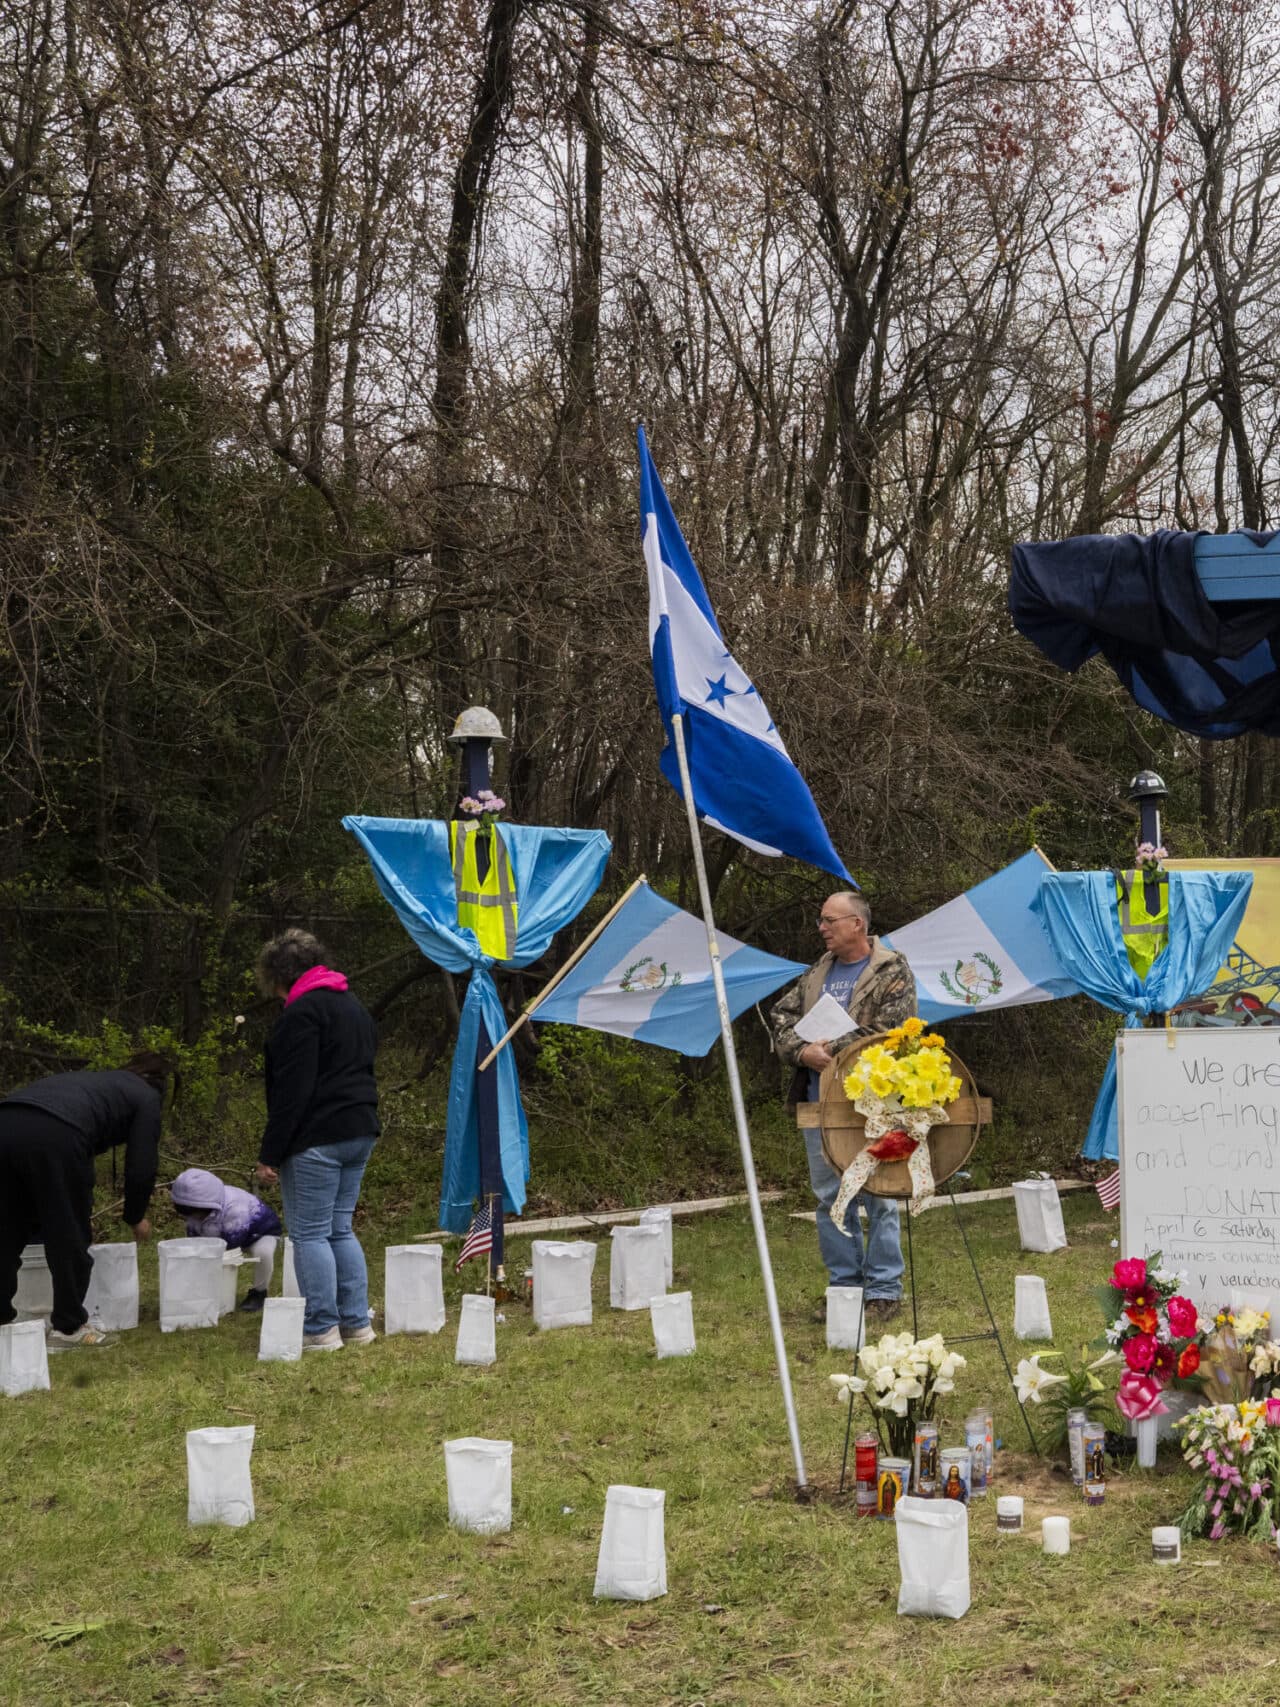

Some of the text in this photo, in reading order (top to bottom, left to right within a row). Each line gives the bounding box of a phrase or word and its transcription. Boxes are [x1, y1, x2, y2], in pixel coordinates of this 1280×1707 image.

[1183, 1057, 1225, 1085] We
[1136, 1087, 1278, 1143] accepting
[1135, 1133, 1187, 1172] and
[1144, 1213, 1185, 1242] April
[1193, 1218, 1208, 1238] 6
